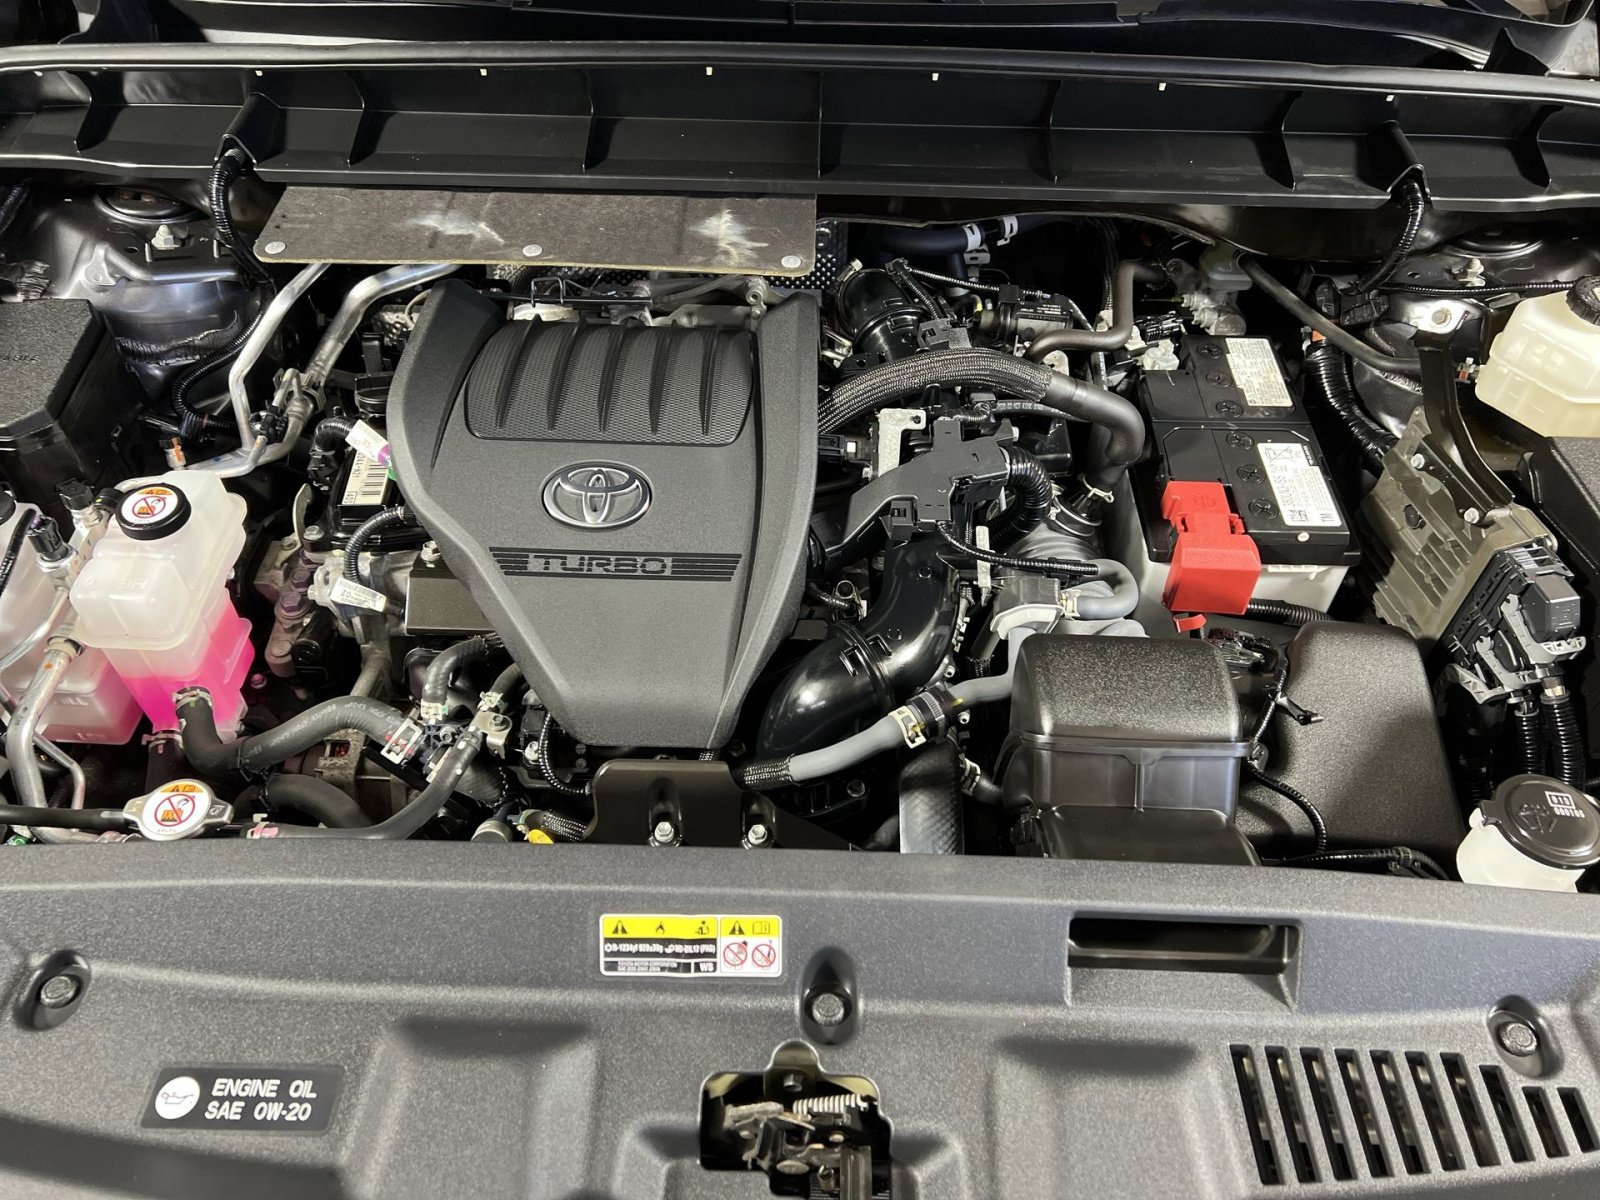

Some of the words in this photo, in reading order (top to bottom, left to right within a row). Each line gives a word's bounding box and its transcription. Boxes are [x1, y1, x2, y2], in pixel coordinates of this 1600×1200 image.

[533, 555, 667, 574] TURBO
[211, 1078, 280, 1098] ENGINE
[288, 1079, 317, 1099] OIL
[204, 1101, 245, 1121] SAE
[253, 1102, 312, 1121] 0W-20
